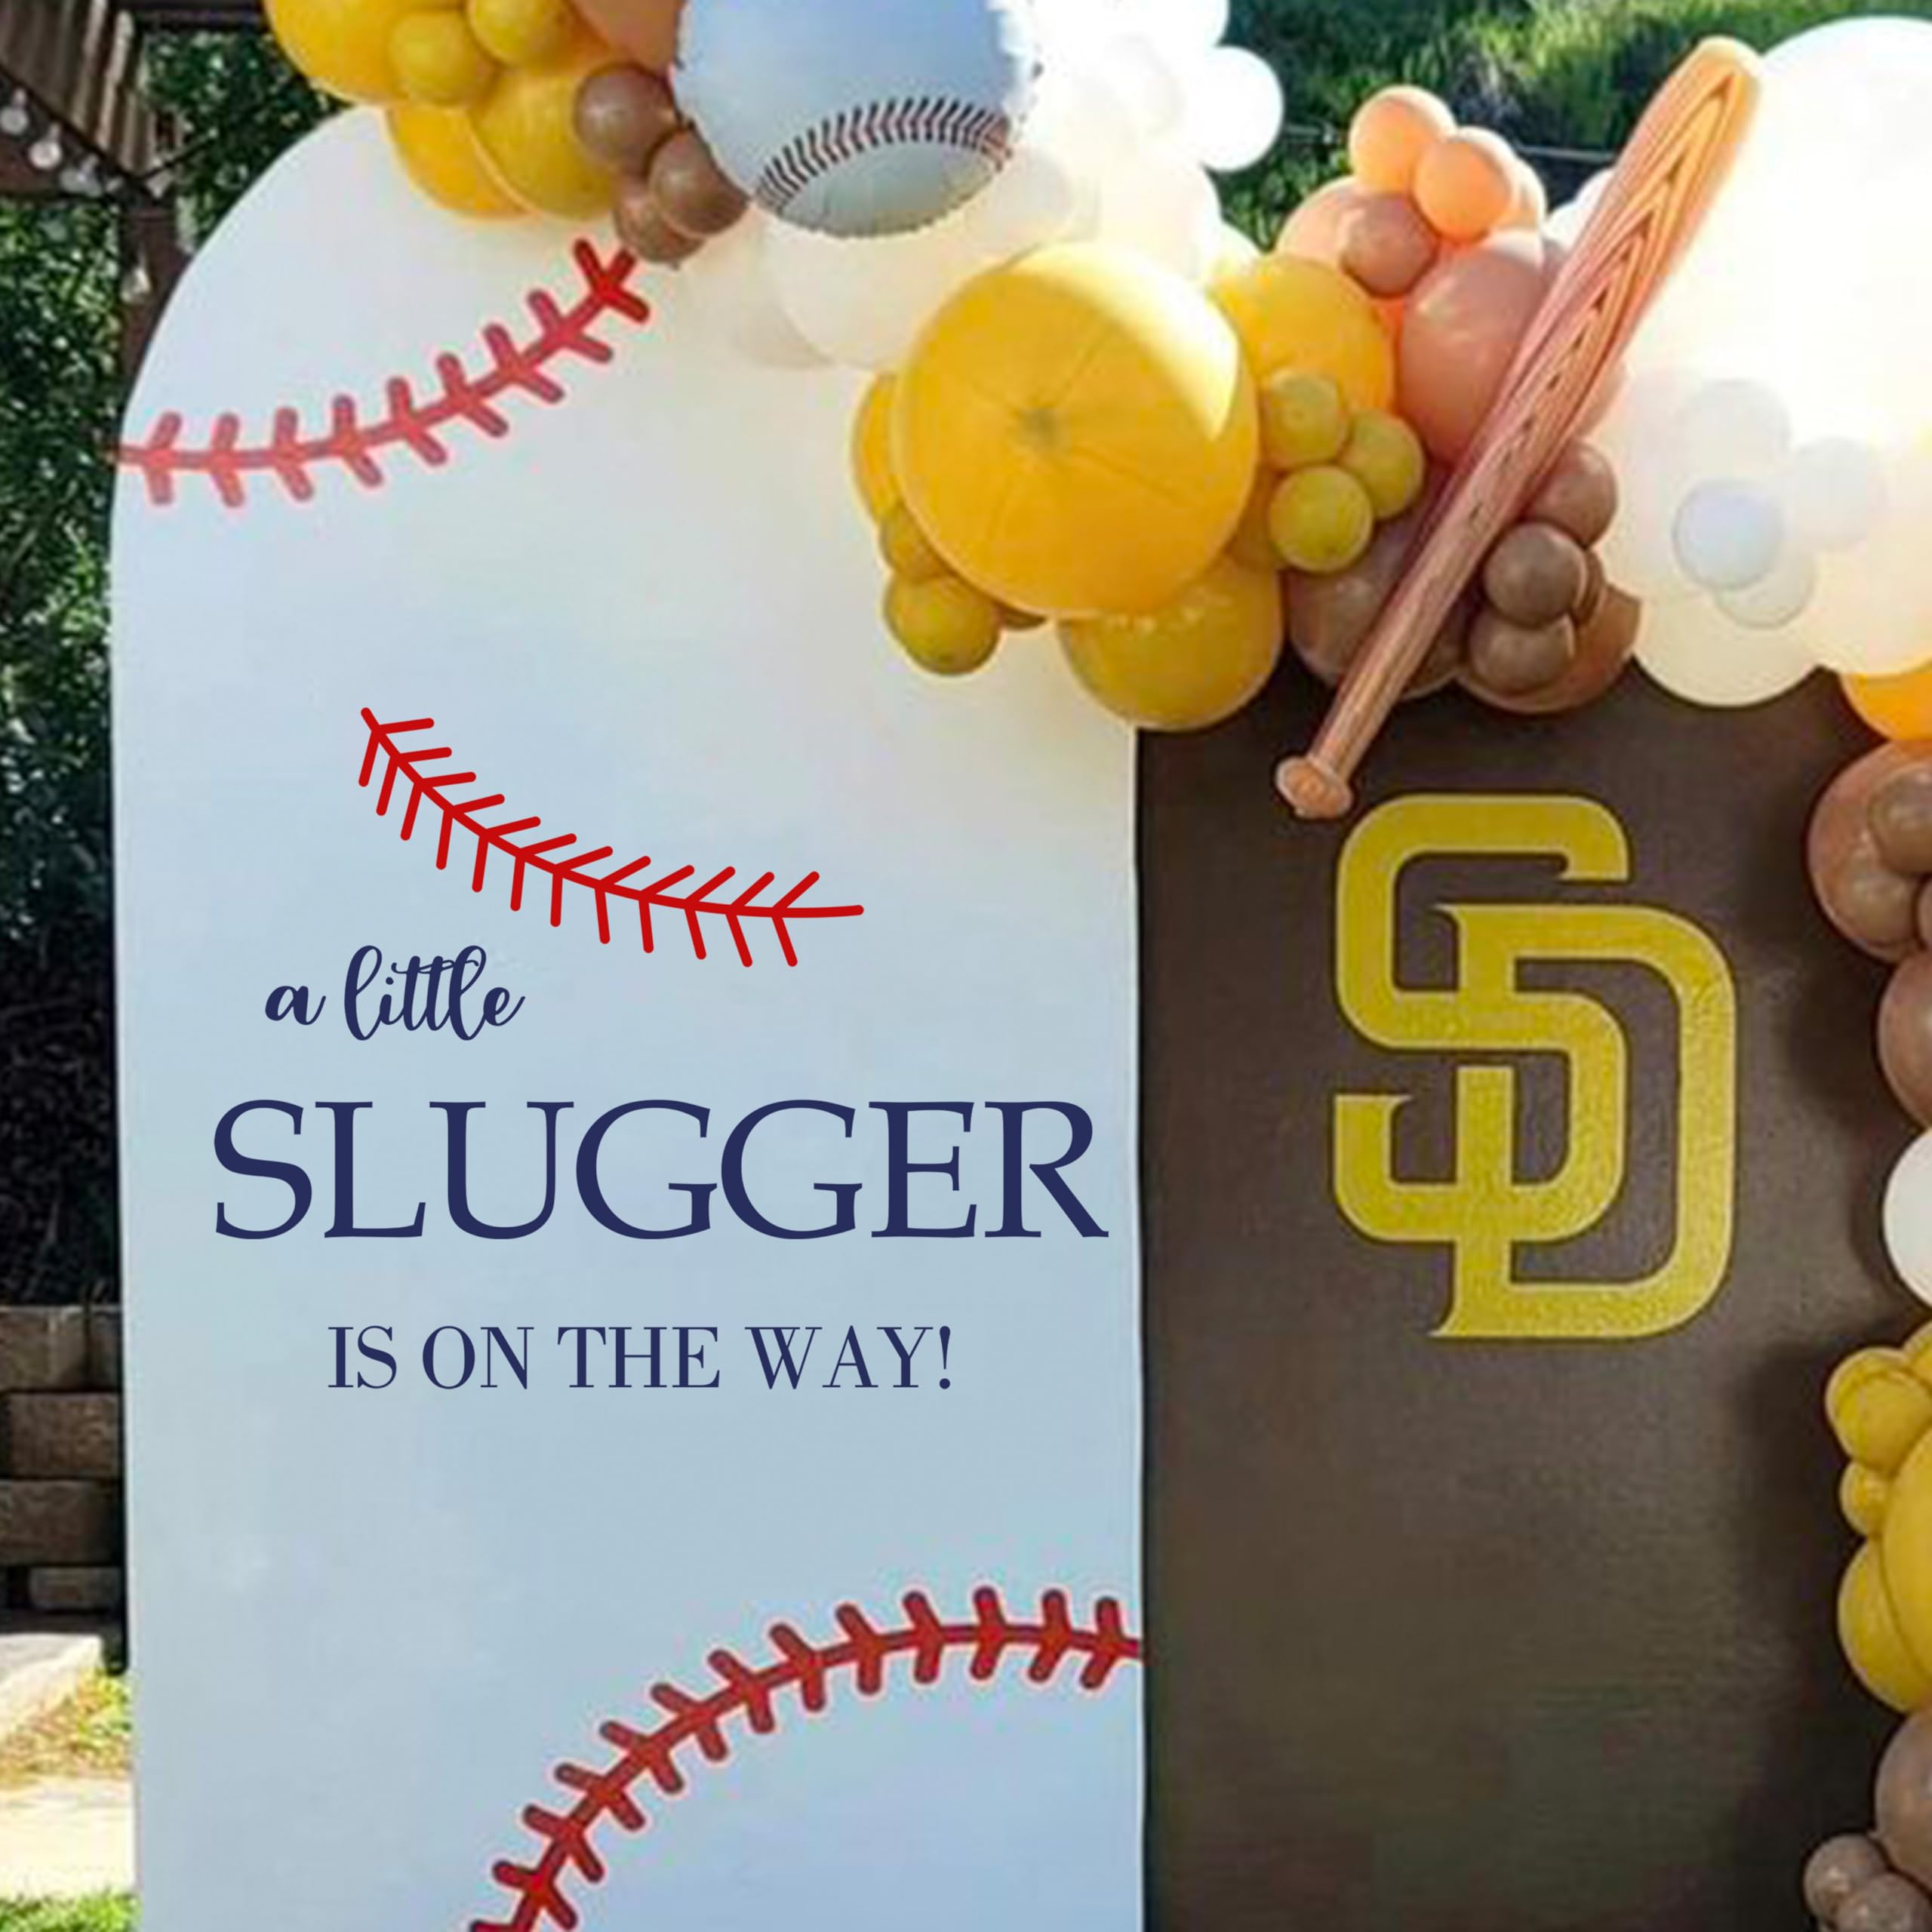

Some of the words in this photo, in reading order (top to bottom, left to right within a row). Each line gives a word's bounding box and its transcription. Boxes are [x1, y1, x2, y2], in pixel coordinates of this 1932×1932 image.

[265, 985, 327, 1026] a
[343, 945, 526, 1041] little
[1333, 793, 1737, 1339] SD
[214, 1099, 1109, 1240] SLUGGER
[328, 1325, 397, 1389] IS
[422, 1325, 535, 1390] ON
[557, 1326, 720, 1388] THE
[744, 1325, 951, 1390] WAY!
